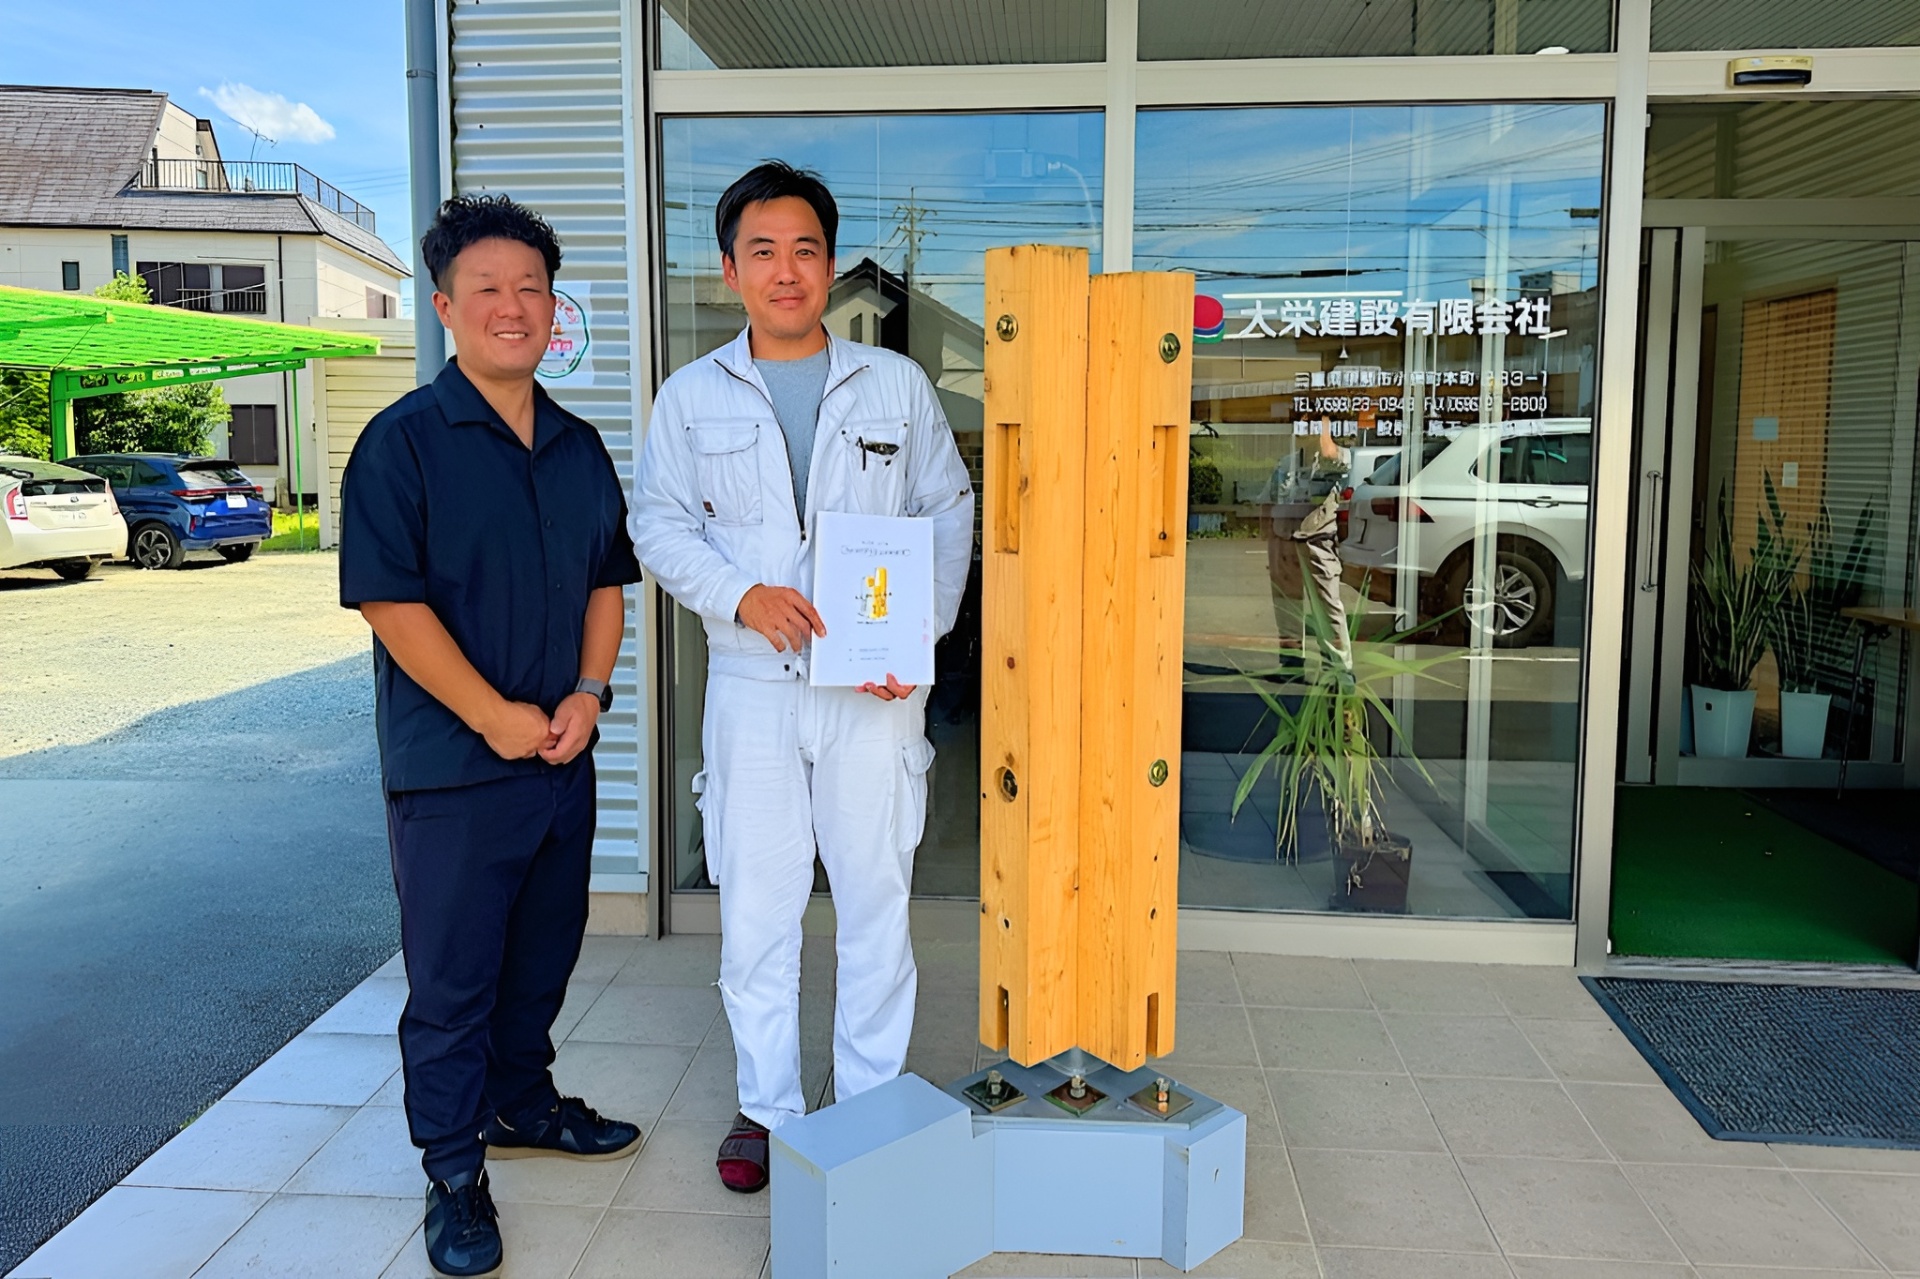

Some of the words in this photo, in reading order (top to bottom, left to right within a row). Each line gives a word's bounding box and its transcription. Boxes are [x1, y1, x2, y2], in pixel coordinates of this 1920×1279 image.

[1238, 297, 1551, 338] 大栄建設有限会社
